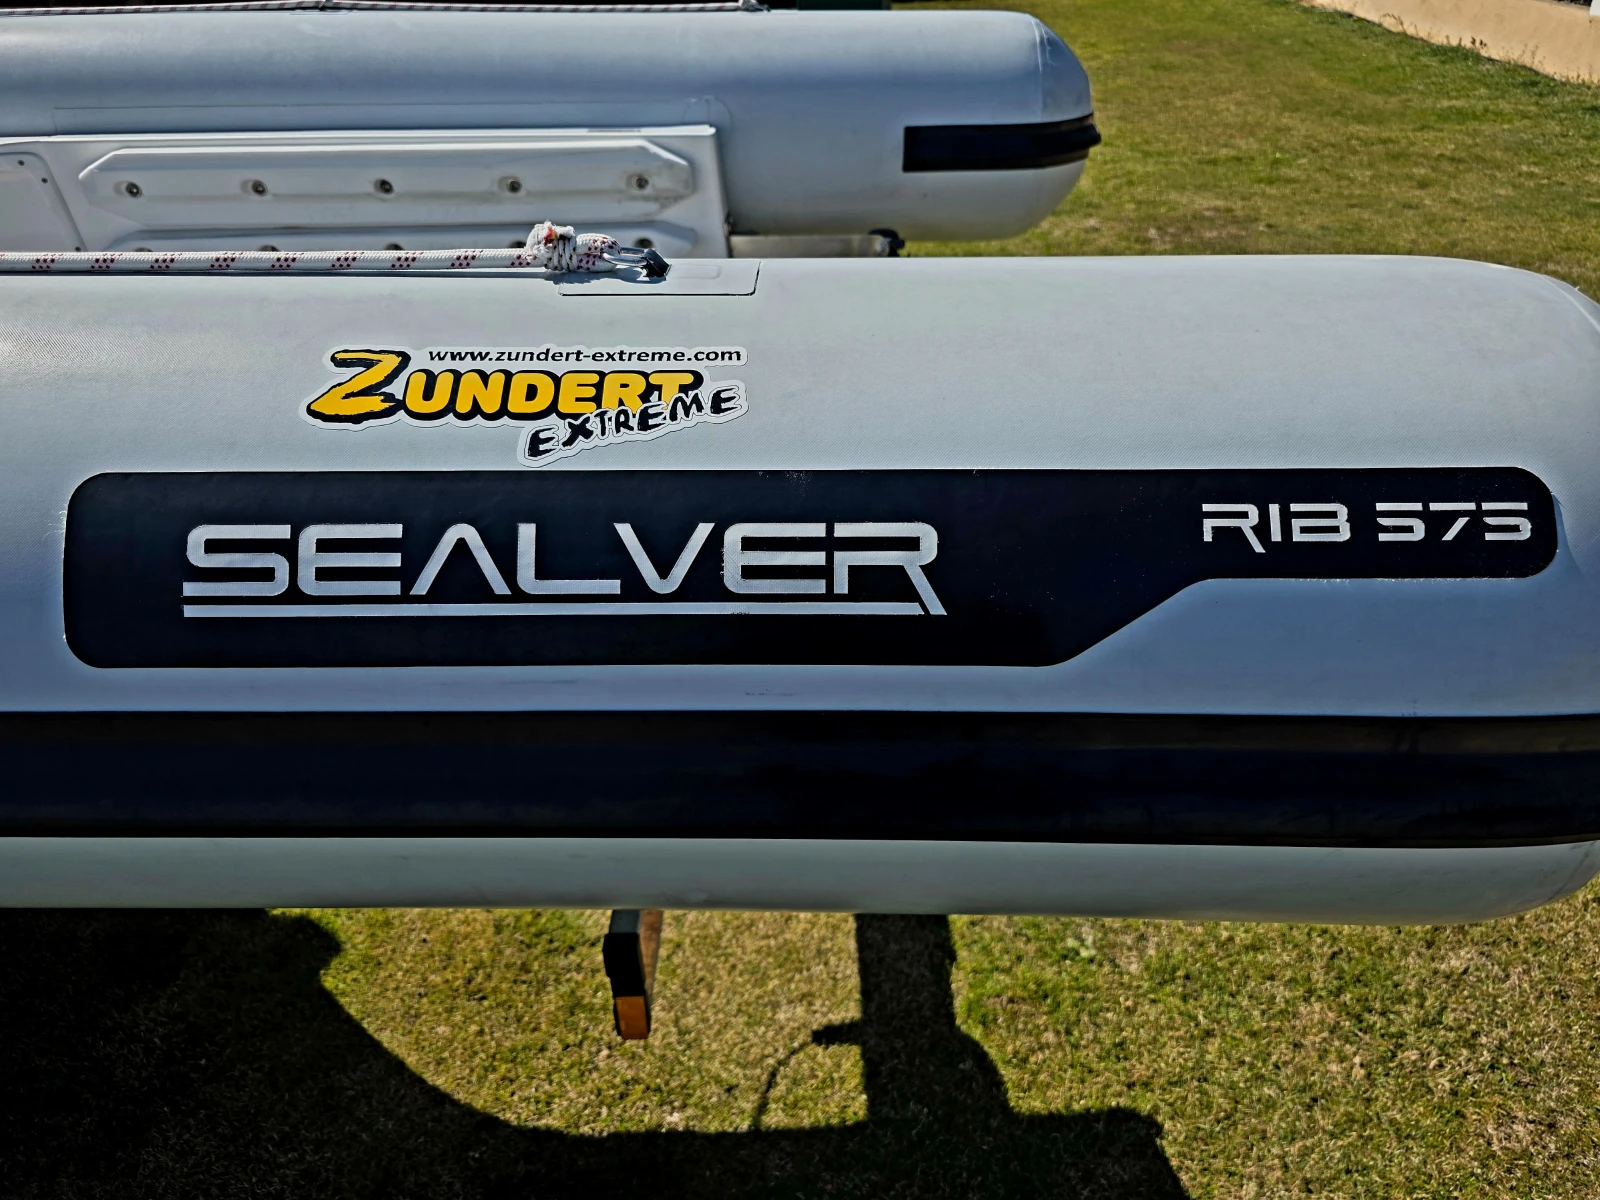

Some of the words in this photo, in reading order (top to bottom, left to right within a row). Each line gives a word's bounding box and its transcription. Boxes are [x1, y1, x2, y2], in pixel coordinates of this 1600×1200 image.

[306, 349, 701, 422] ZUNDERT
[428, 347, 742, 363] www.zundert-extreme.com
[528, 386, 742, 459] EXTREME
[1202, 503, 1351, 553] RIB
[1375, 502, 1533, 542] 575
[181, 522, 948, 616] SEALVER
